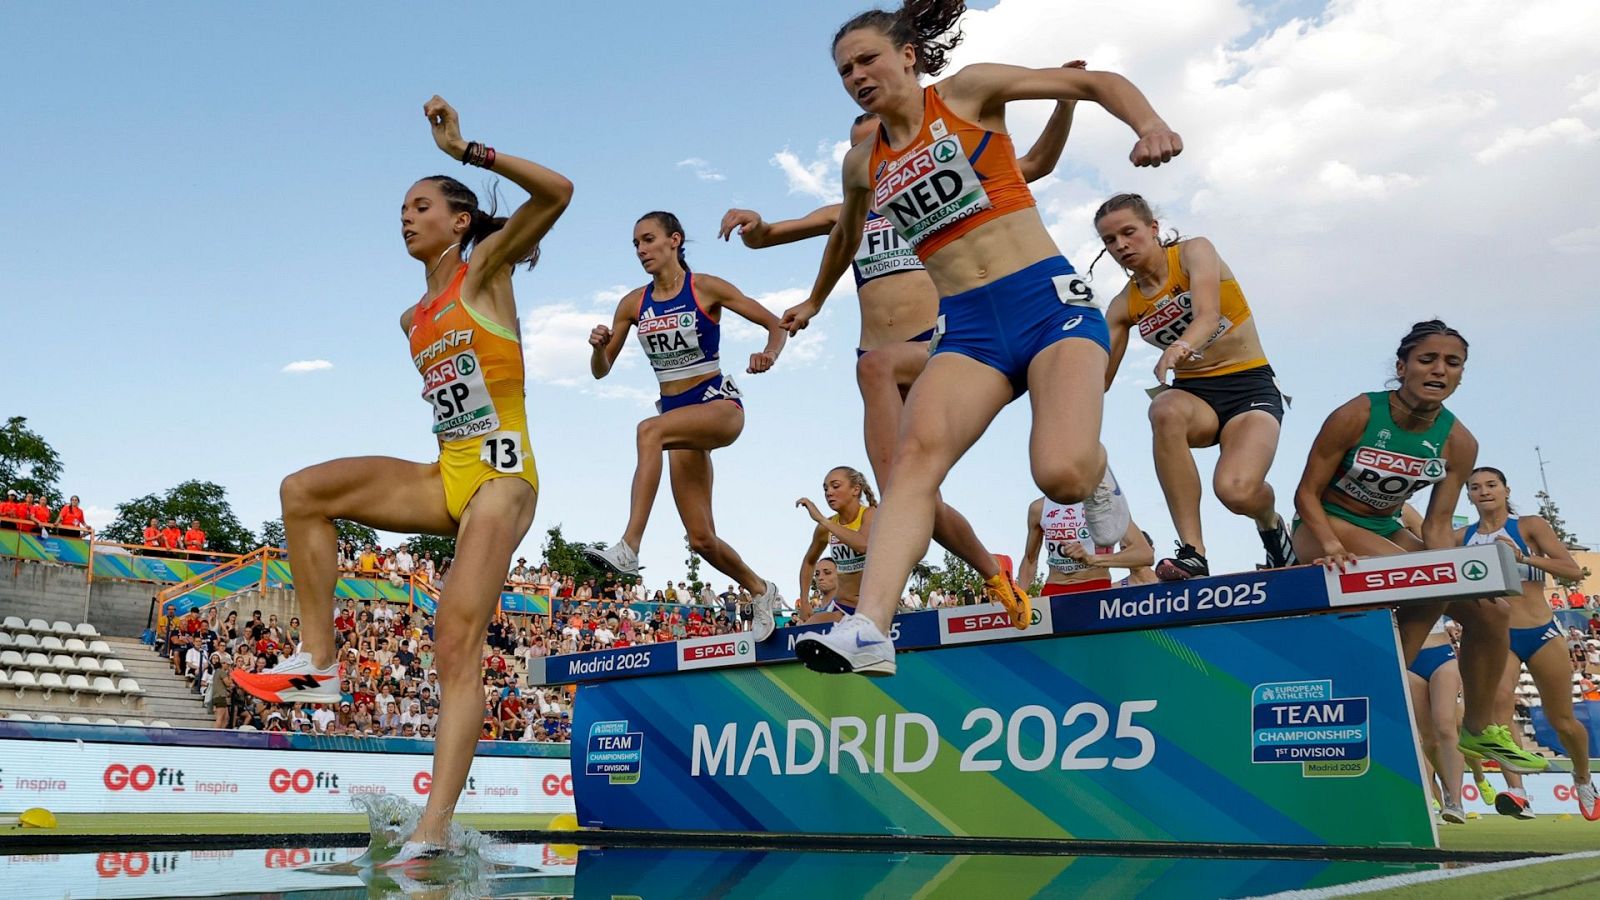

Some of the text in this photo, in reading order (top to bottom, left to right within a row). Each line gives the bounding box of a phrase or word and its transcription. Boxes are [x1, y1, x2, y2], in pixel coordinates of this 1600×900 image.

[876, 153, 933, 199] SPAR
[888, 169, 963, 227] NED
[930, 202, 960, 222] CLEAN
[889, 249, 913, 258] CLEAN
[865, 257, 922, 275] MADRID 202
[1069, 279, 1093, 302] 9
[640, 316, 678, 333] SPAR
[1140, 304, 1181, 335] SPAR
[646, 331, 690, 353] FRA
[425, 363, 456, 391] PAR
[451, 413, 474, 427] CLEAN
[466, 418, 492, 435] 2025
[485, 438, 518, 468] 13
[1358, 450, 1424, 474] SPAR
[1345, 482, 1389, 508] MADRID
[1046, 529, 1076, 539] SPAR
[1365, 566, 1455, 588] SPAR
[1100, 582, 1267, 620] Madrid 2025
[964, 612, 1012, 630] SPA
[695, 643, 735, 658] SPAR
[569, 652, 650, 675] Madrid 2025
[1275, 685, 1323, 693] EUROPEAN
[1276, 691, 1324, 700] ATHLETICS
[1271, 704, 1344, 724] TEAM
[598, 736, 632, 750] TEAM
[690, 700, 1157, 776] MADRID 2025
[1259, 729, 1362, 742] CHAMPIONSHIPS
[1275, 747, 1345, 758] 1ST DIVISION
[604, 764, 630, 772] DIVISION
[1308, 763, 1361, 772] Madrid 2025
[16, 777, 67, 792] inspira
[195, 781, 238, 794] inspira
[348, 783, 386, 796] inspira
[484, 785, 518, 798] inspira
